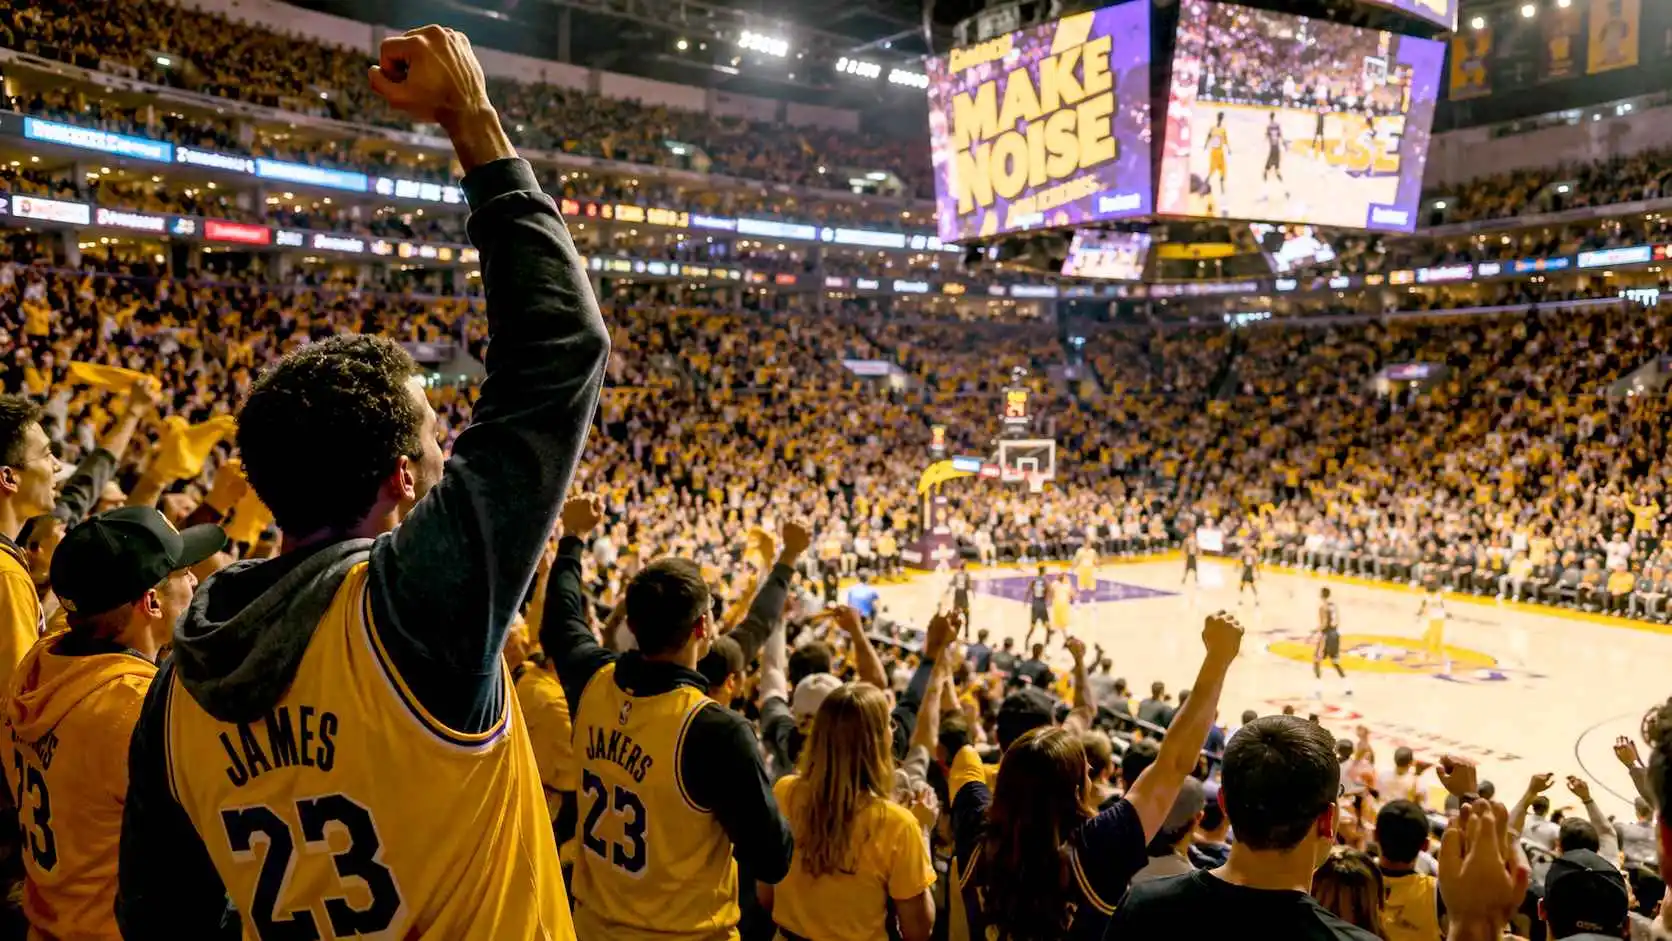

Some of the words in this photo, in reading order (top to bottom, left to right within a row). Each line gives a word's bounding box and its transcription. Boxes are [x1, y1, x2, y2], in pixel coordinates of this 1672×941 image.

[953, 35, 1114, 153] MAKE
[956, 91, 1116, 216] NOISE
[218, 704, 338, 788] JAMES
[219, 791, 406, 941] 23
[581, 767, 648, 877] 23
